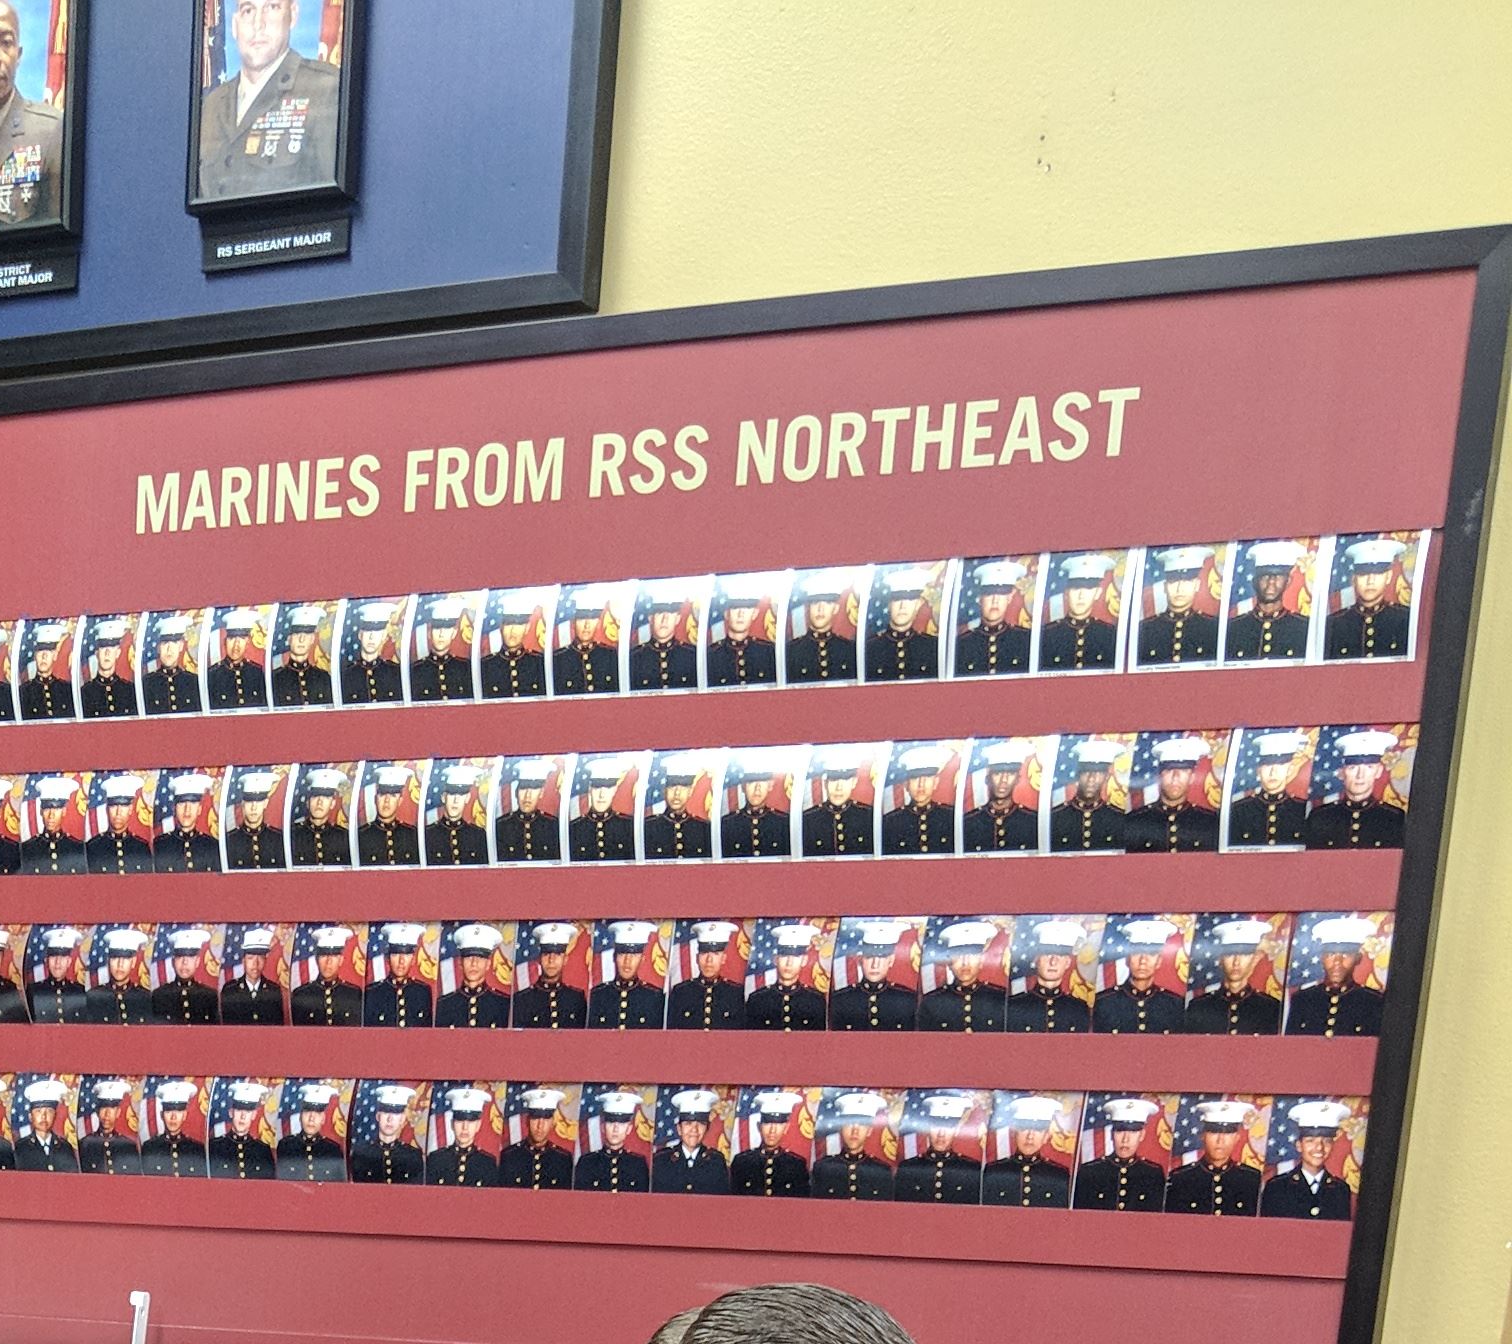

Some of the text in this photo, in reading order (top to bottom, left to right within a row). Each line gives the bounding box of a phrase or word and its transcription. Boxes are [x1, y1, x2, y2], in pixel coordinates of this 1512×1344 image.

[216, 231, 331, 258] RS SERGEANT MAJOR
[17, 271, 53, 287] MAJOR
[134, 386, 1141, 536] MARINES FROM RSS NORTHEAST
